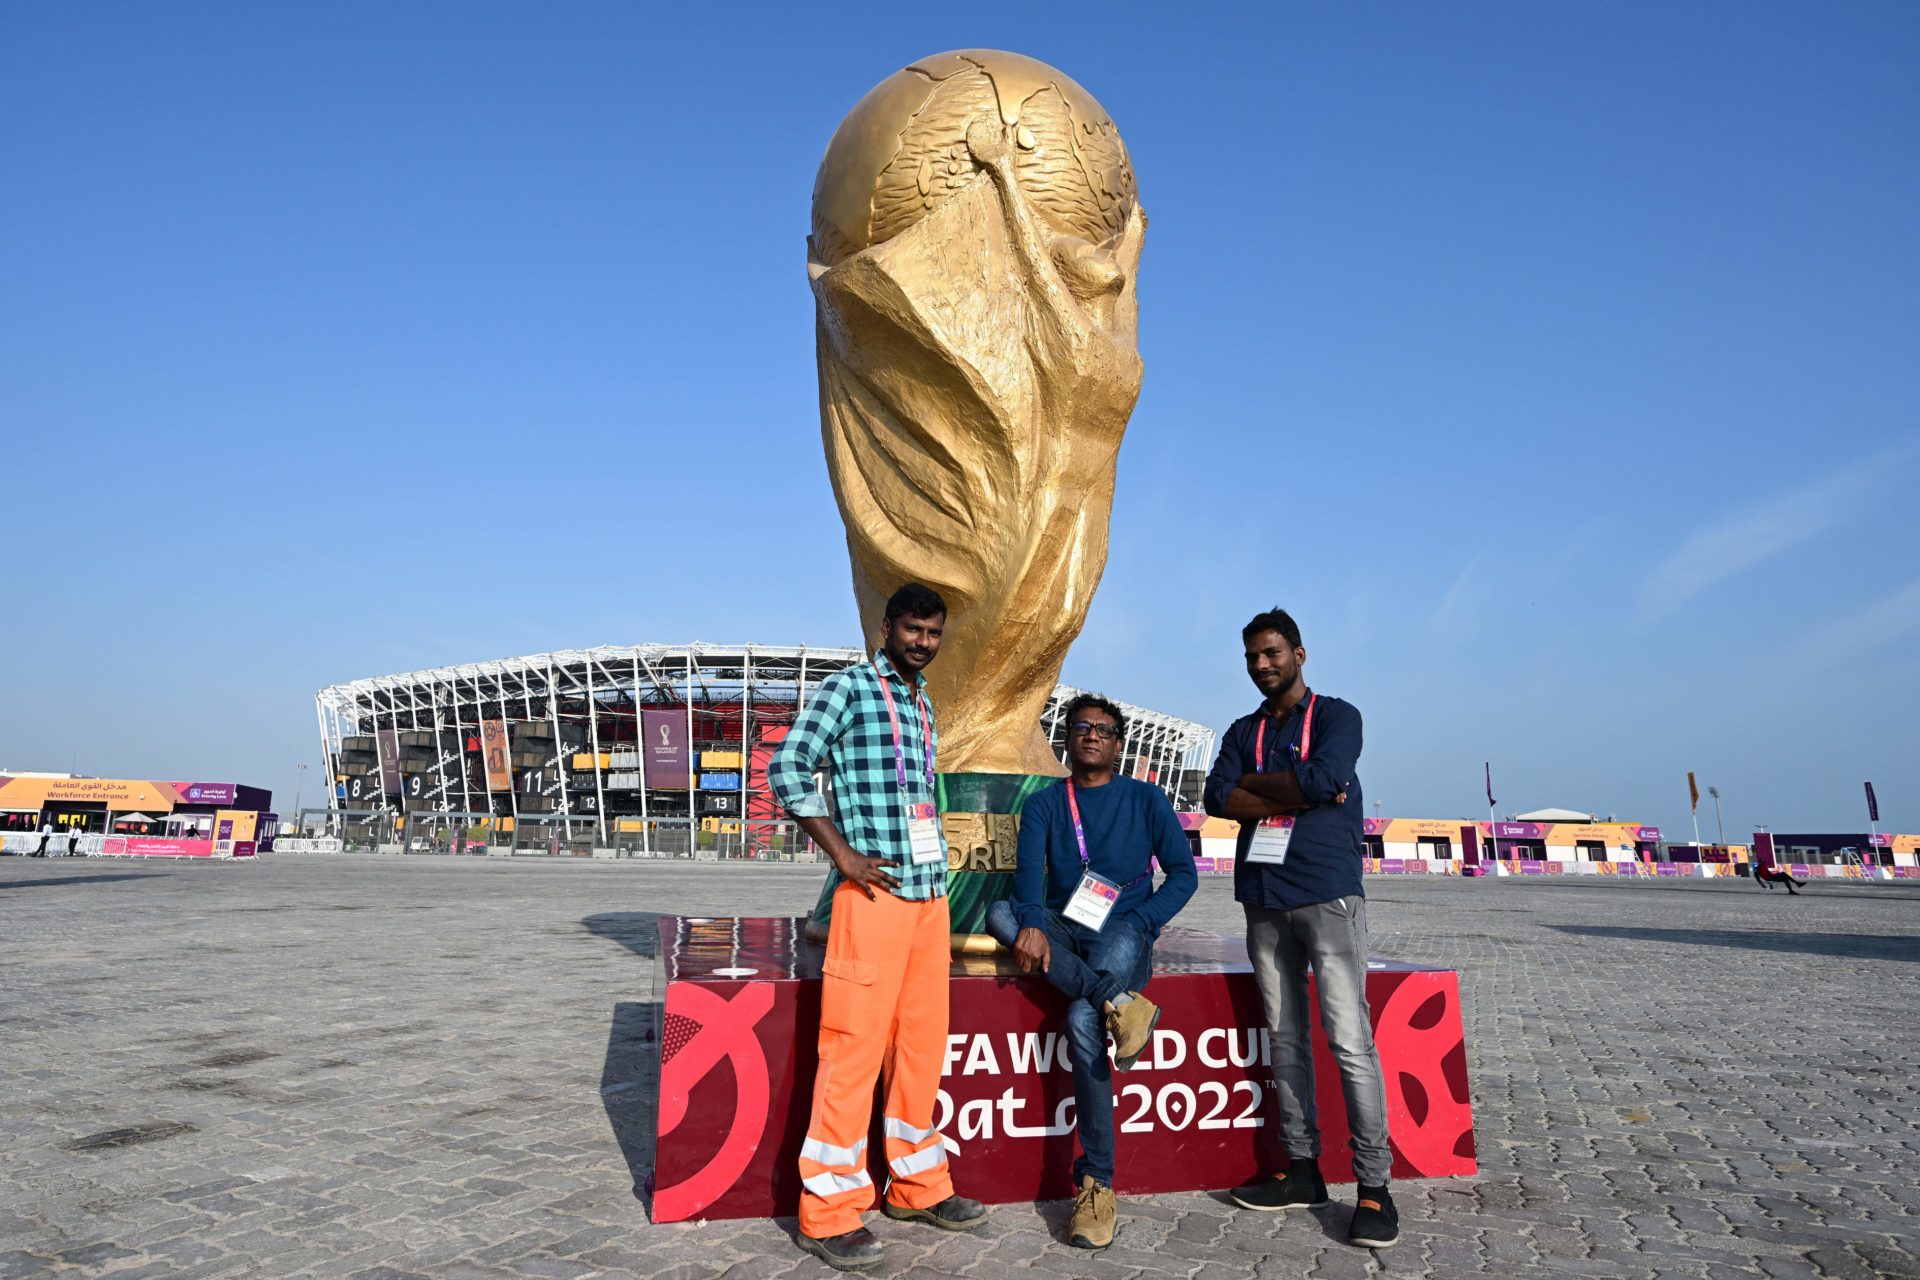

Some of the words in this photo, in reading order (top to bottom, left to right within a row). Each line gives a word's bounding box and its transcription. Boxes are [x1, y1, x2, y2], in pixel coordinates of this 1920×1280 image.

[352, 779, 361, 797] 8
[411, 776, 421, 796] 9
[524, 771, 542, 793] 11
[47, 791, 91, 799] Workforce
[92, 792, 129, 800] Entrance
[585, 797, 596, 809] 12
[714, 797, 728, 809] 13
[948, 841, 1018, 870] ORL
[941, 1033, 1001, 1076] FA
[933, 1086, 1119, 1157] Qata
[1120, 1080, 1265, 1134] 2022
